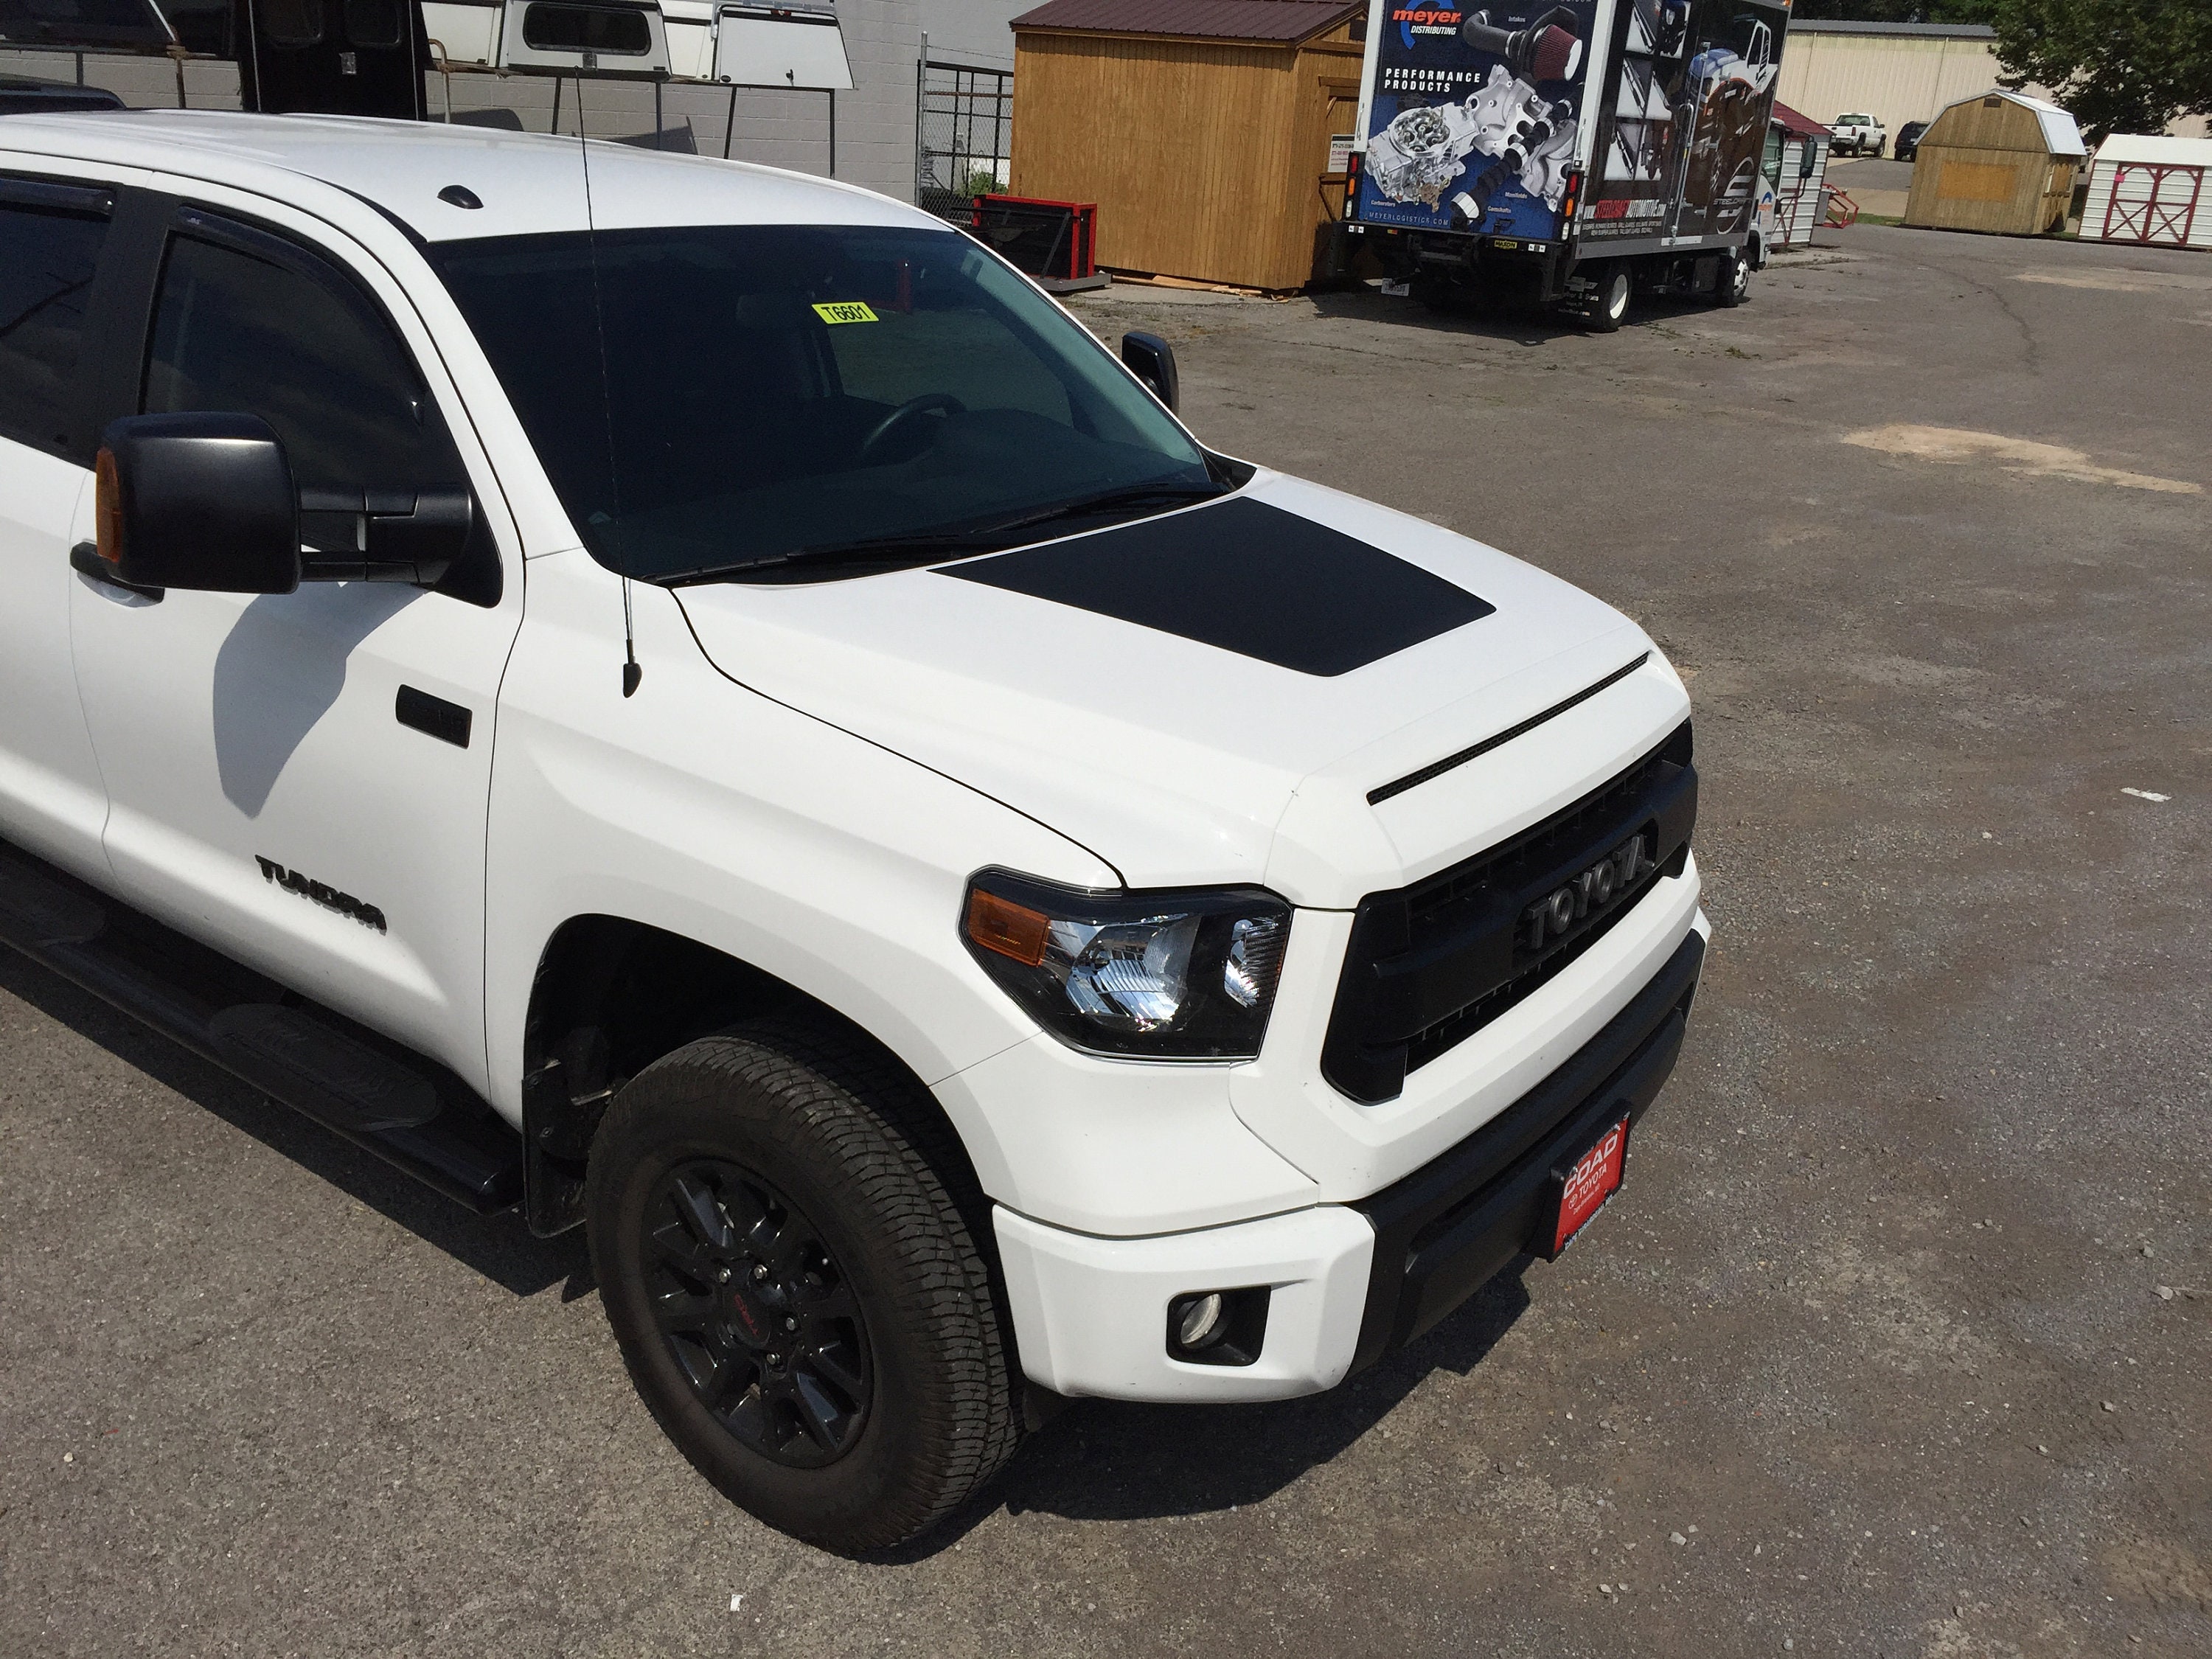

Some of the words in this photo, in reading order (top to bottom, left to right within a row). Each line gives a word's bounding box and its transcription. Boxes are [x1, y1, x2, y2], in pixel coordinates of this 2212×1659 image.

[1392, 9, 1462, 25] meyer
[1411, 25, 1457, 35] DISTRIBUTING
[1385, 68, 1481, 83] PERFORMANCE
[1384, 80, 1451, 93] PRODUCTS
[820, 305, 871, 321] T6601
[254, 854, 387, 932] TUNDRA
[1527, 834, 1655, 950] TOYOTA
[1563, 1133, 1618, 1200] COAD
[1579, 1162, 1607, 1199] TOYOTA
